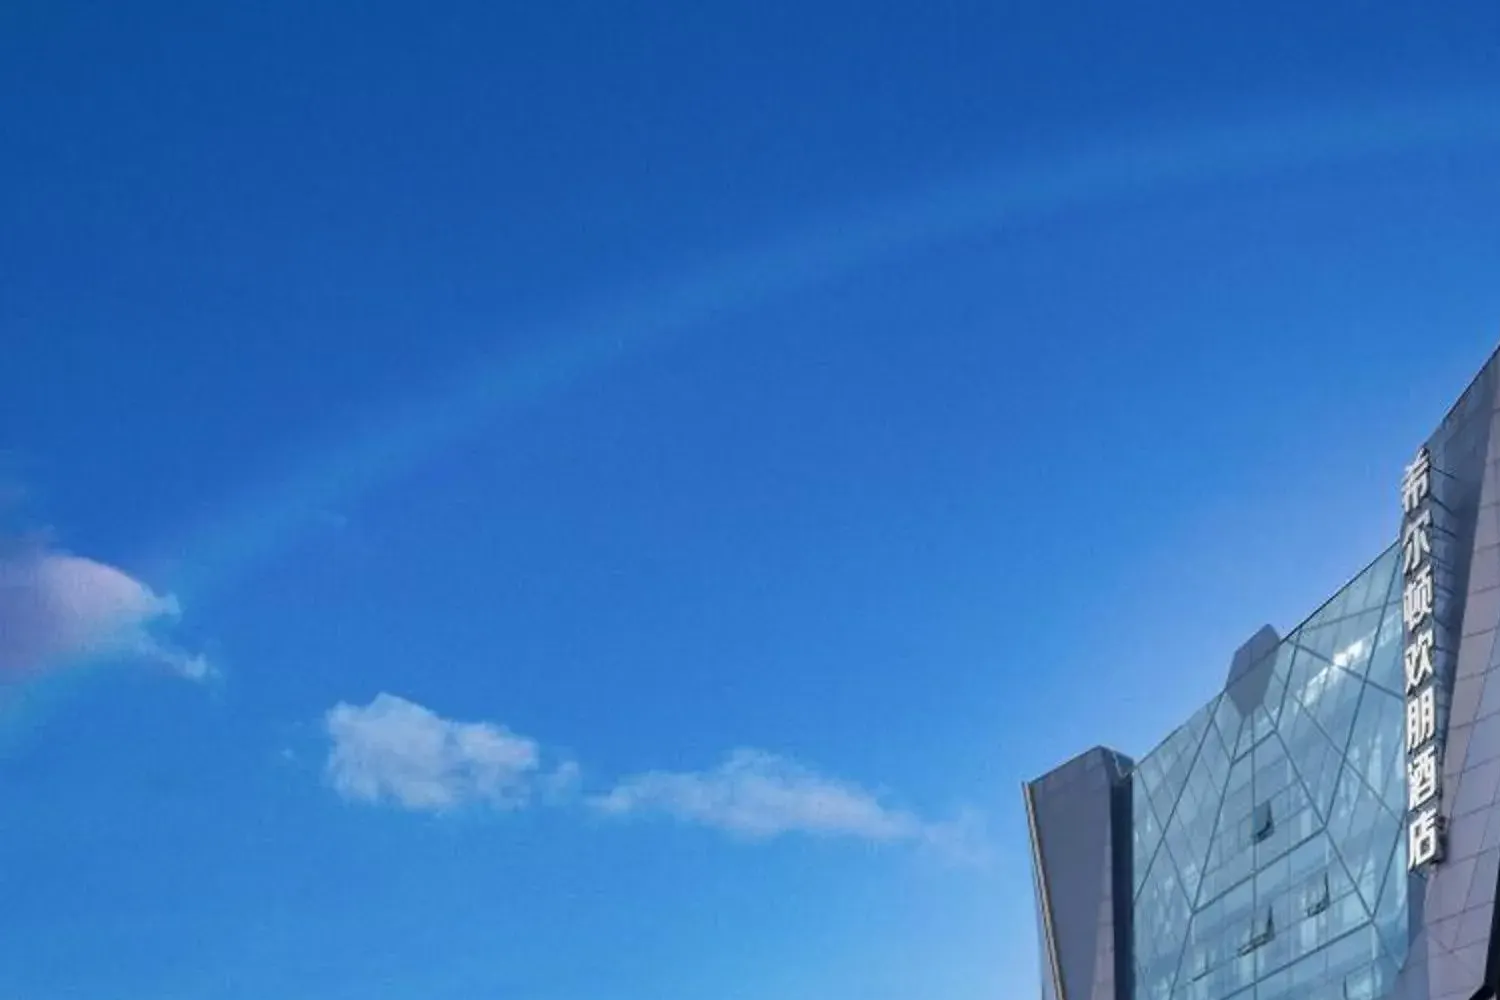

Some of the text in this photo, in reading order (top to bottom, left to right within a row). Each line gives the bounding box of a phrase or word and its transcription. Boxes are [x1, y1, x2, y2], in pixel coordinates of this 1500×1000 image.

[1402, 447, 1439, 871] 希尔顿欢朋酒店
